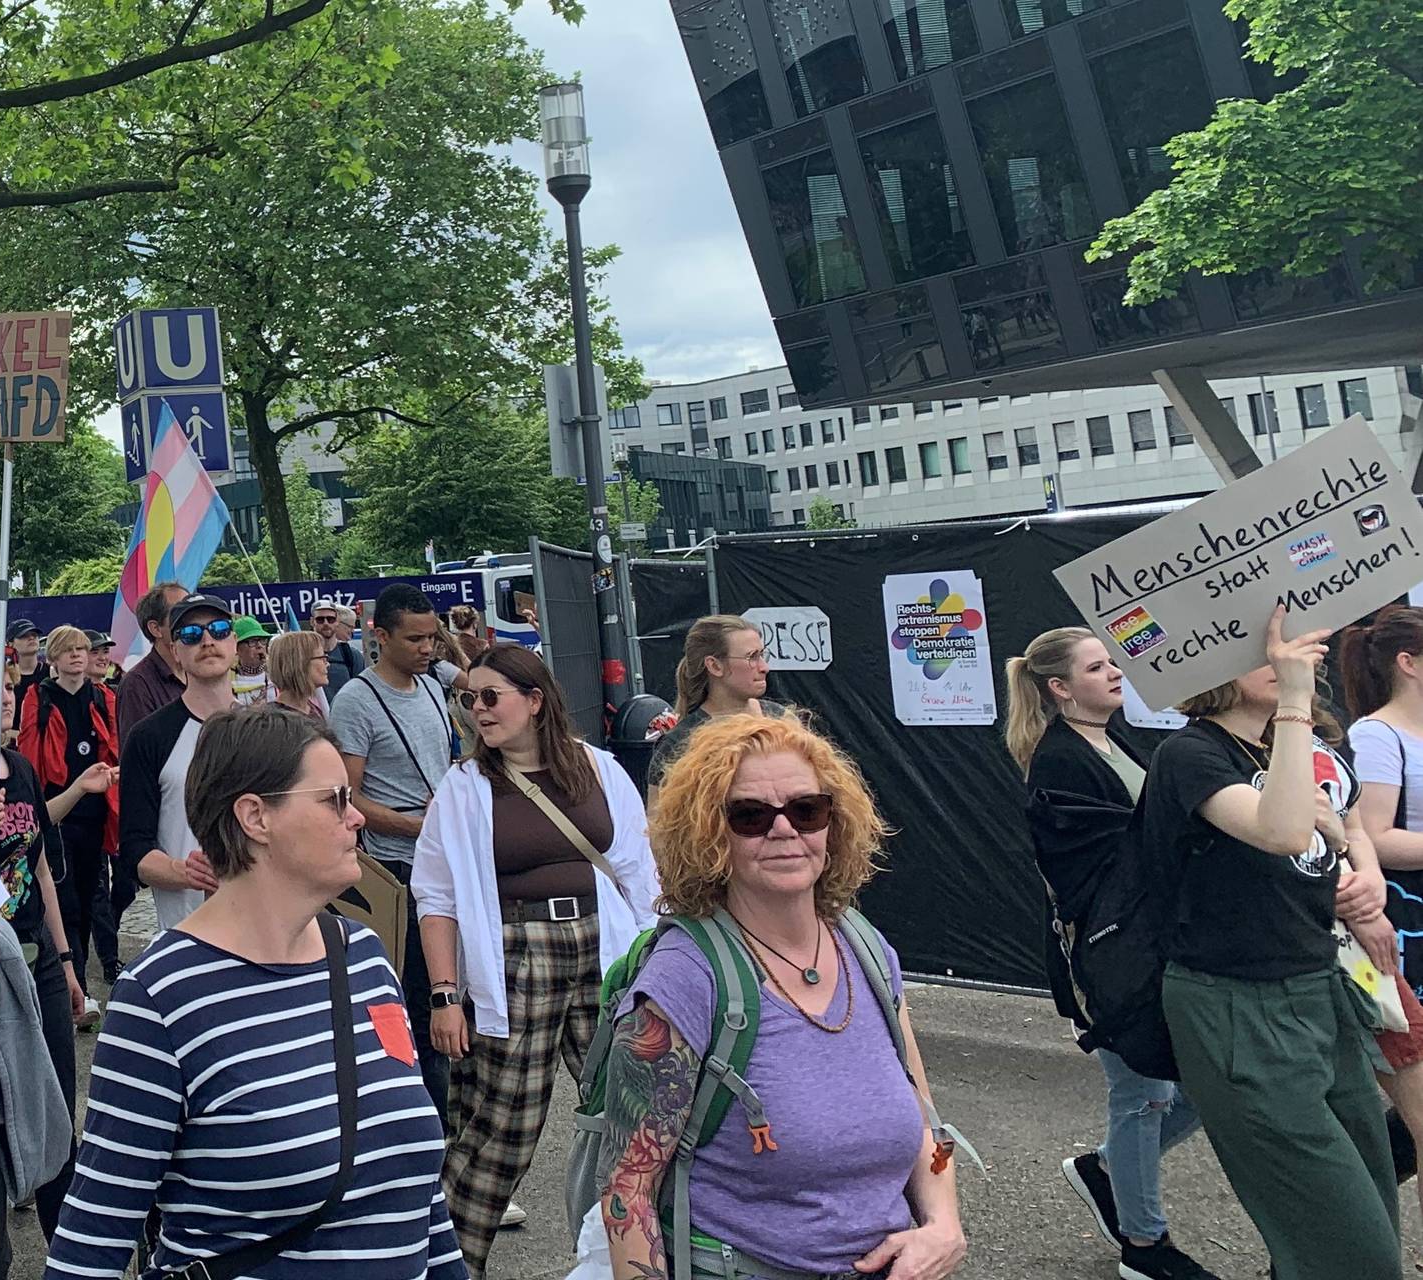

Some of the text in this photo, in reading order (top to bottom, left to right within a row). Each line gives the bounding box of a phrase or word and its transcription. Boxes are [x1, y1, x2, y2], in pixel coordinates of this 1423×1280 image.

[116, 321, 135, 389] U
[152, 314, 207, 380] U
[1089, 457, 1388, 612] Menschenrechte
[1290, 533, 1327, 555] SMASH
[1204, 554, 1273, 599] statt
[230, 587, 357, 617] rliner Platz
[421, 580, 475, 602] Eingang E
[1148, 526, 1421, 674] rechte Menschen!
[897, 604, 936, 614] Rechts-
[898, 614, 963, 626] extremismus
[899, 626, 940, 638] stoppen
[1108, 615, 1139, 636] free
[761, 621, 832, 662] RESSE
[913, 637, 975, 649] Demokratie
[1121, 630, 1153, 651] free
[917, 649, 976, 661] verteidigen
